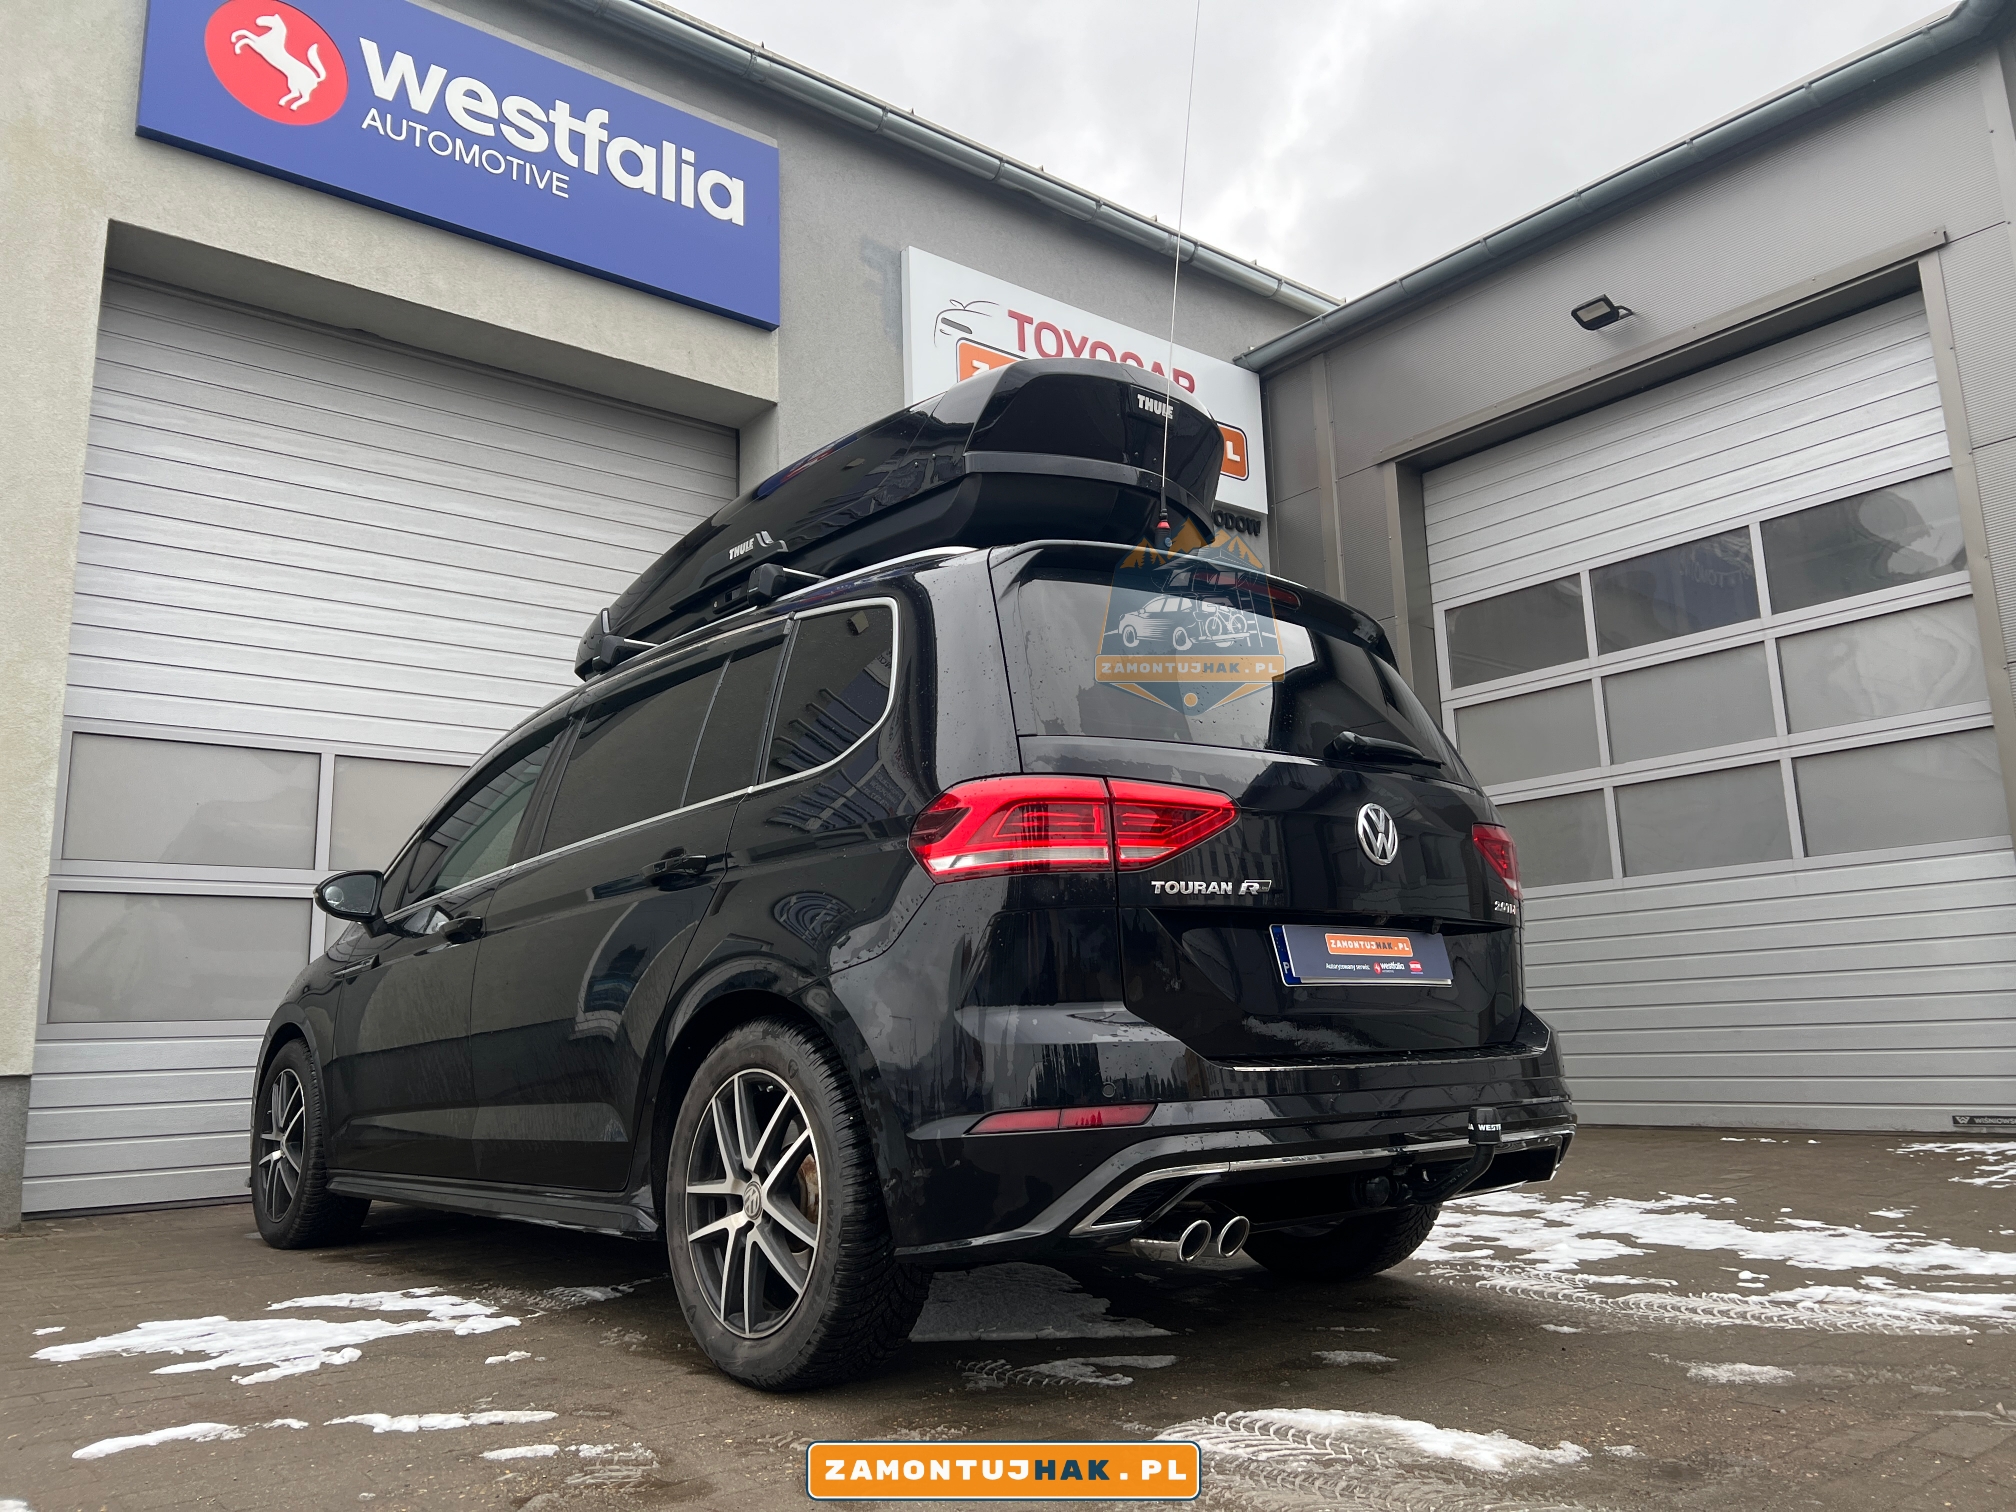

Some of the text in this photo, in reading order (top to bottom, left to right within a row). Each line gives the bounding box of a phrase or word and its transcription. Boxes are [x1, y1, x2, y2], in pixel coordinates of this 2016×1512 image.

[358, 36, 745, 227] westfalia
[361, 107, 570, 199] AUTOMOTIVE
[1137, 393, 1174, 419] THULE
[729, 537, 755, 560] THULE
[1150, 880, 1233, 895] TOURAN
[1282, 961, 1290, 974] P
